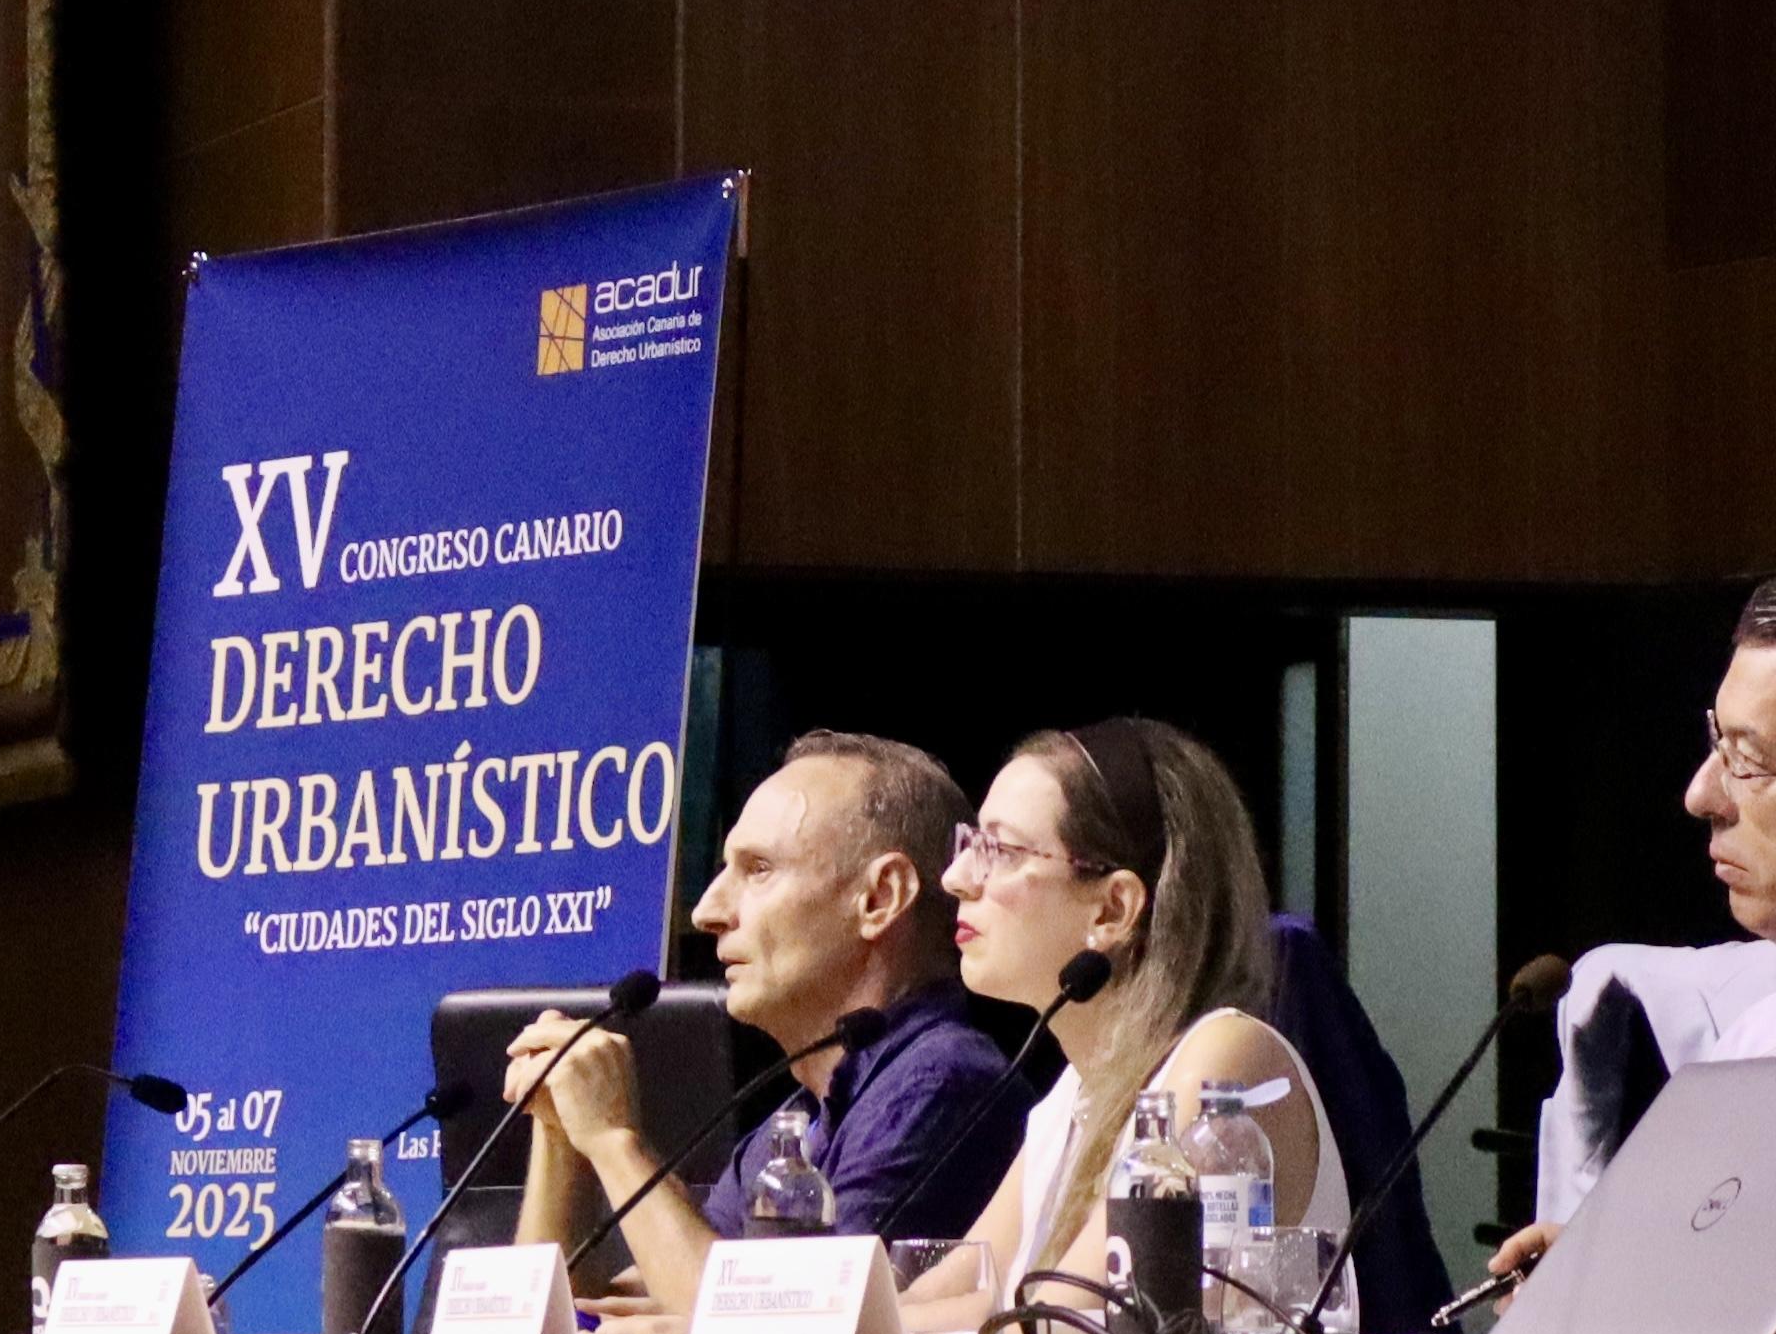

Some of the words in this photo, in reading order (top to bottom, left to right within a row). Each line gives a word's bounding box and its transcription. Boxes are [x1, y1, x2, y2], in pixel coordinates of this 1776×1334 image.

[594, 260, 703, 314] acadur
[688, 310, 703, 326] de
[591, 346, 636, 367] Derecho
[639, 338, 701, 360] Urbanístico
[213, 450, 349, 597] XV
[340, 527, 488, 583] CONGRESO
[494, 508, 622, 564] CANARIO
[204, 604, 541, 733] DERECHO
[195, 740, 674, 879] URBANÍSTICO
[403, 901, 455, 945] DEL
[461, 895, 541, 941] SIGLO
[175, 1092, 212, 1142] 05
[216, 1098, 236, 1131] al
[243, 1090, 282, 1138] 07
[170, 1148, 277, 1176] NOVIEMBRE
[397, 1130, 429, 1160] Las
[166, 1181, 277, 1252] 2025
